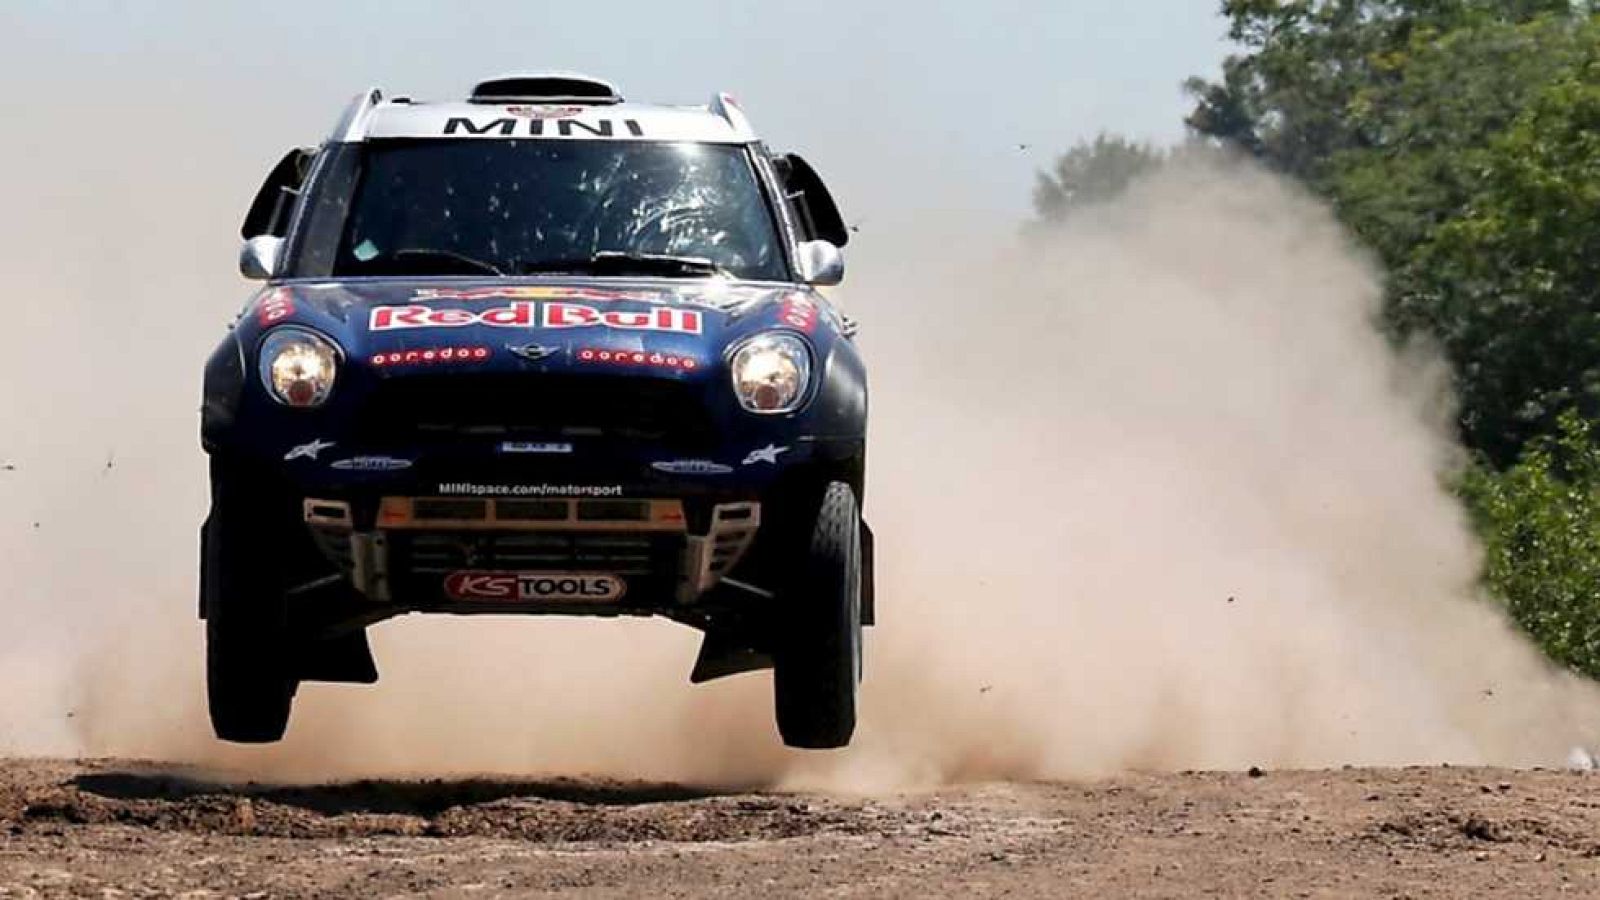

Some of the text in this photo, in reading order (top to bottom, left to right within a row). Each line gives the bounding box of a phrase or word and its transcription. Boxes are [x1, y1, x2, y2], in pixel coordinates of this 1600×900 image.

[444, 118, 644, 136] MINI
[370, 301, 702, 334] Red Bull
[373, 347, 487, 364] ooredoo
[581, 350, 695, 368] ooredoo
[439, 483, 623, 496] MINIspace.com/motorsport
[457, 575, 611, 595] KS TOOLS
